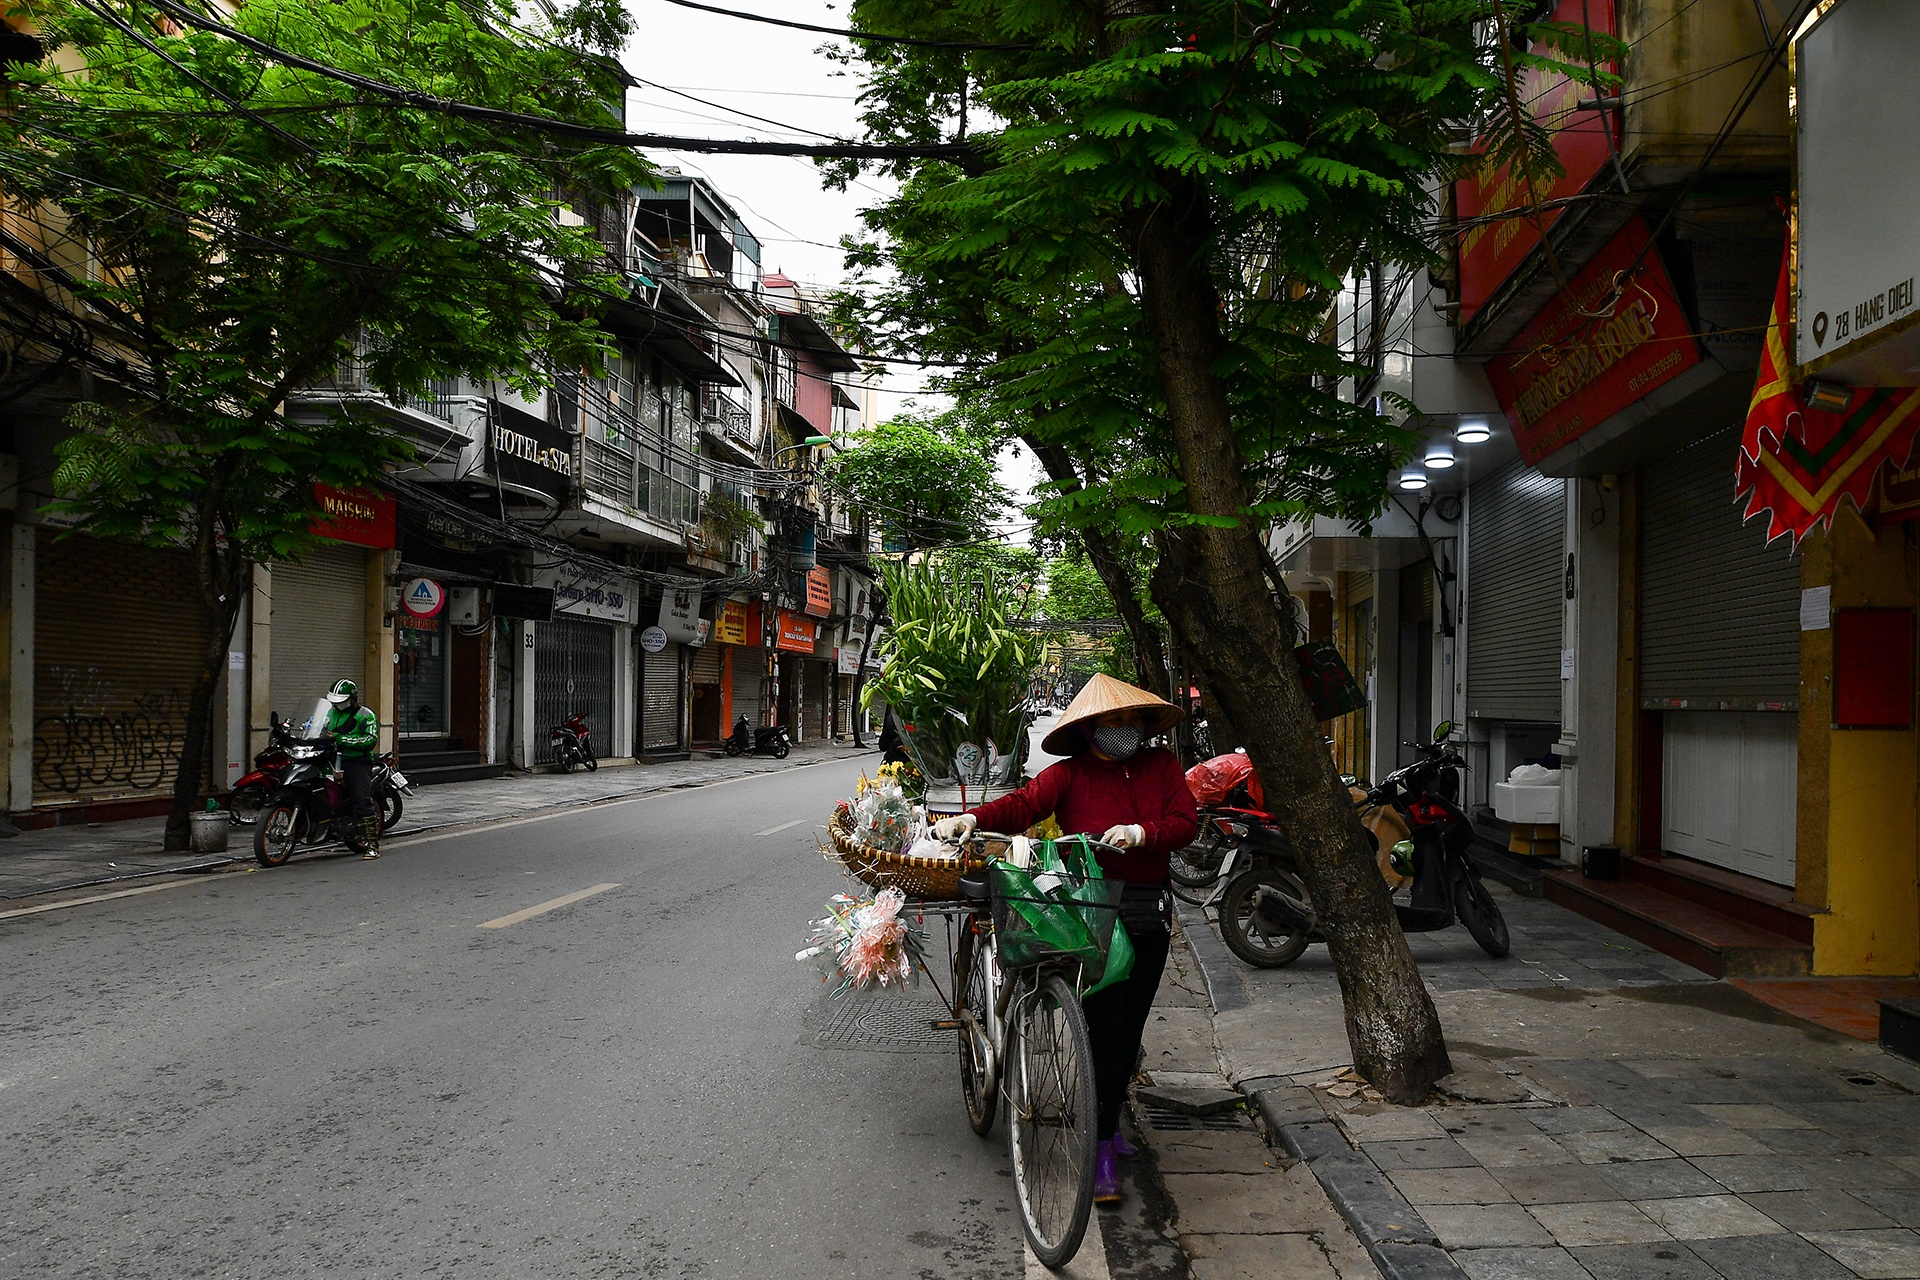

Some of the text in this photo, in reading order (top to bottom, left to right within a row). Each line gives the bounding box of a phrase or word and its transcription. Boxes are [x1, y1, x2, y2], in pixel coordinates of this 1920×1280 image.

[1836, 278, 1913, 340] 28 HANG DIEU
[495, 425, 540, 464] HOTEL
[550, 447, 571, 476] SPA
[525, 633, 534, 649] 33
